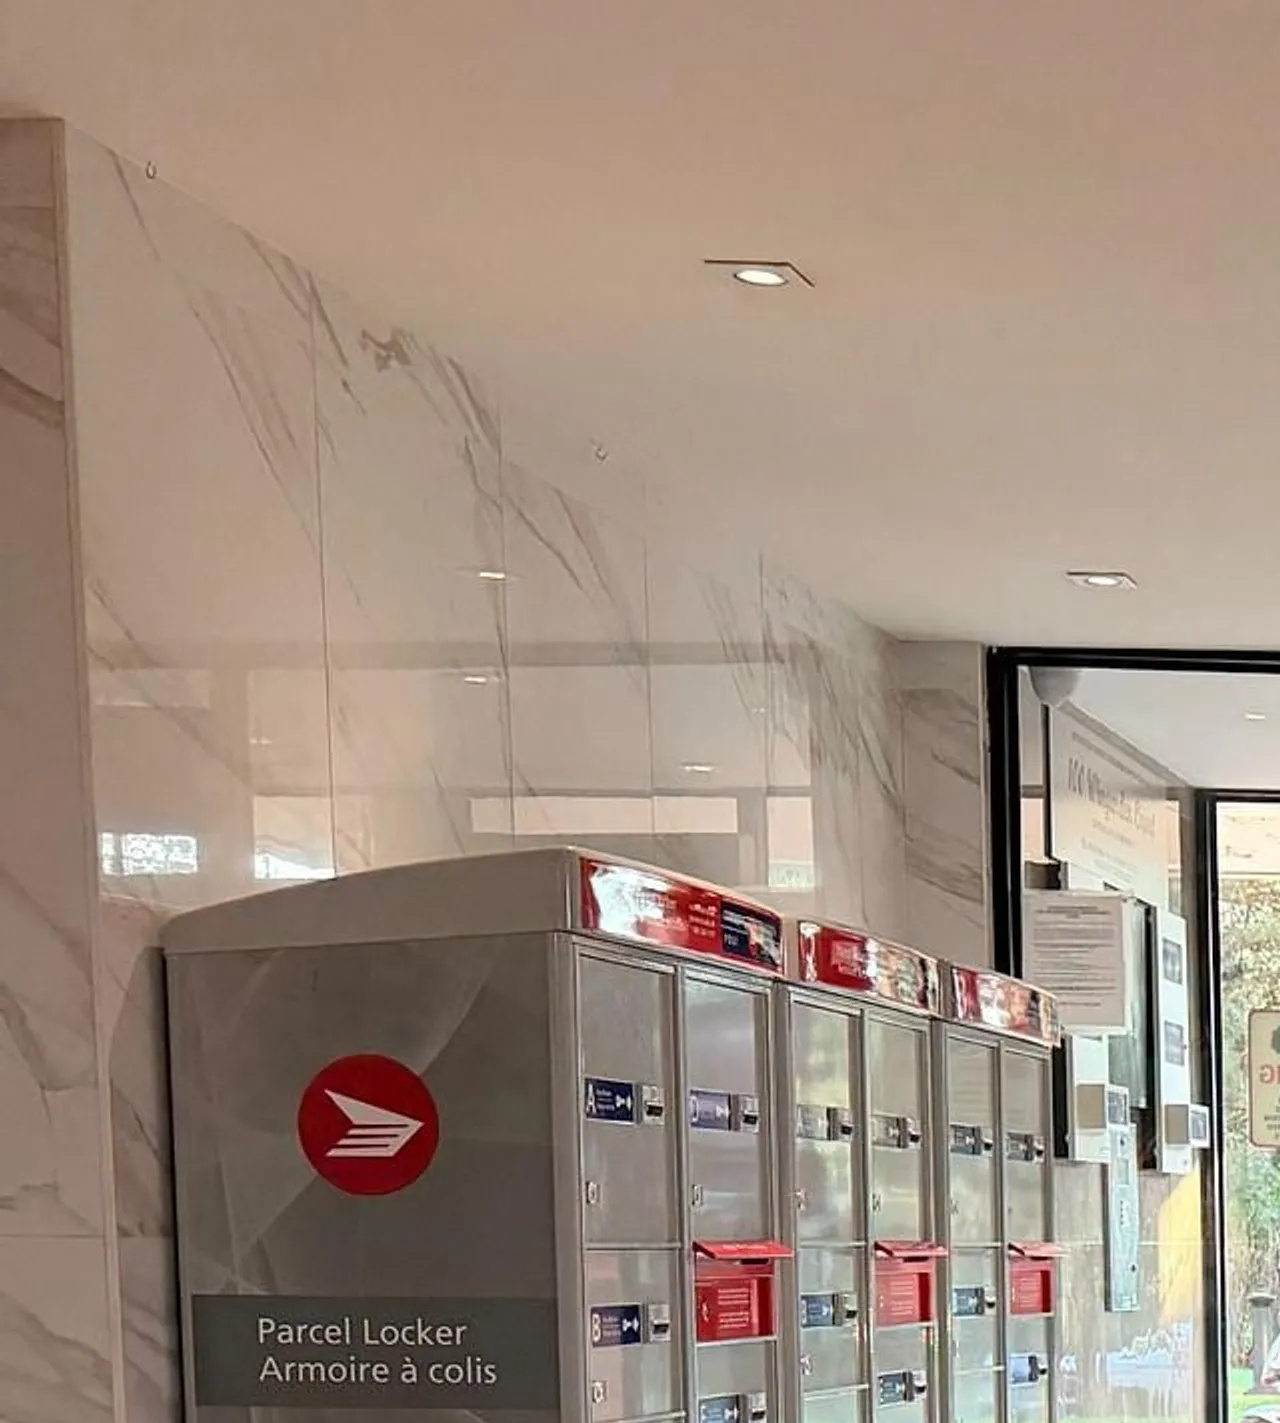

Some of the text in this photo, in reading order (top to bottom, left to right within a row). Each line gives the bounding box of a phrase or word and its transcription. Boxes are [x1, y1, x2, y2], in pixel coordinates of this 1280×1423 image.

[586, 1083, 597, 1113] A
[257, 1317, 468, 1346] Parcel Locker
[592, 1313, 601, 1342] B
[259, 1356, 498, 1384] Armoire à colis
